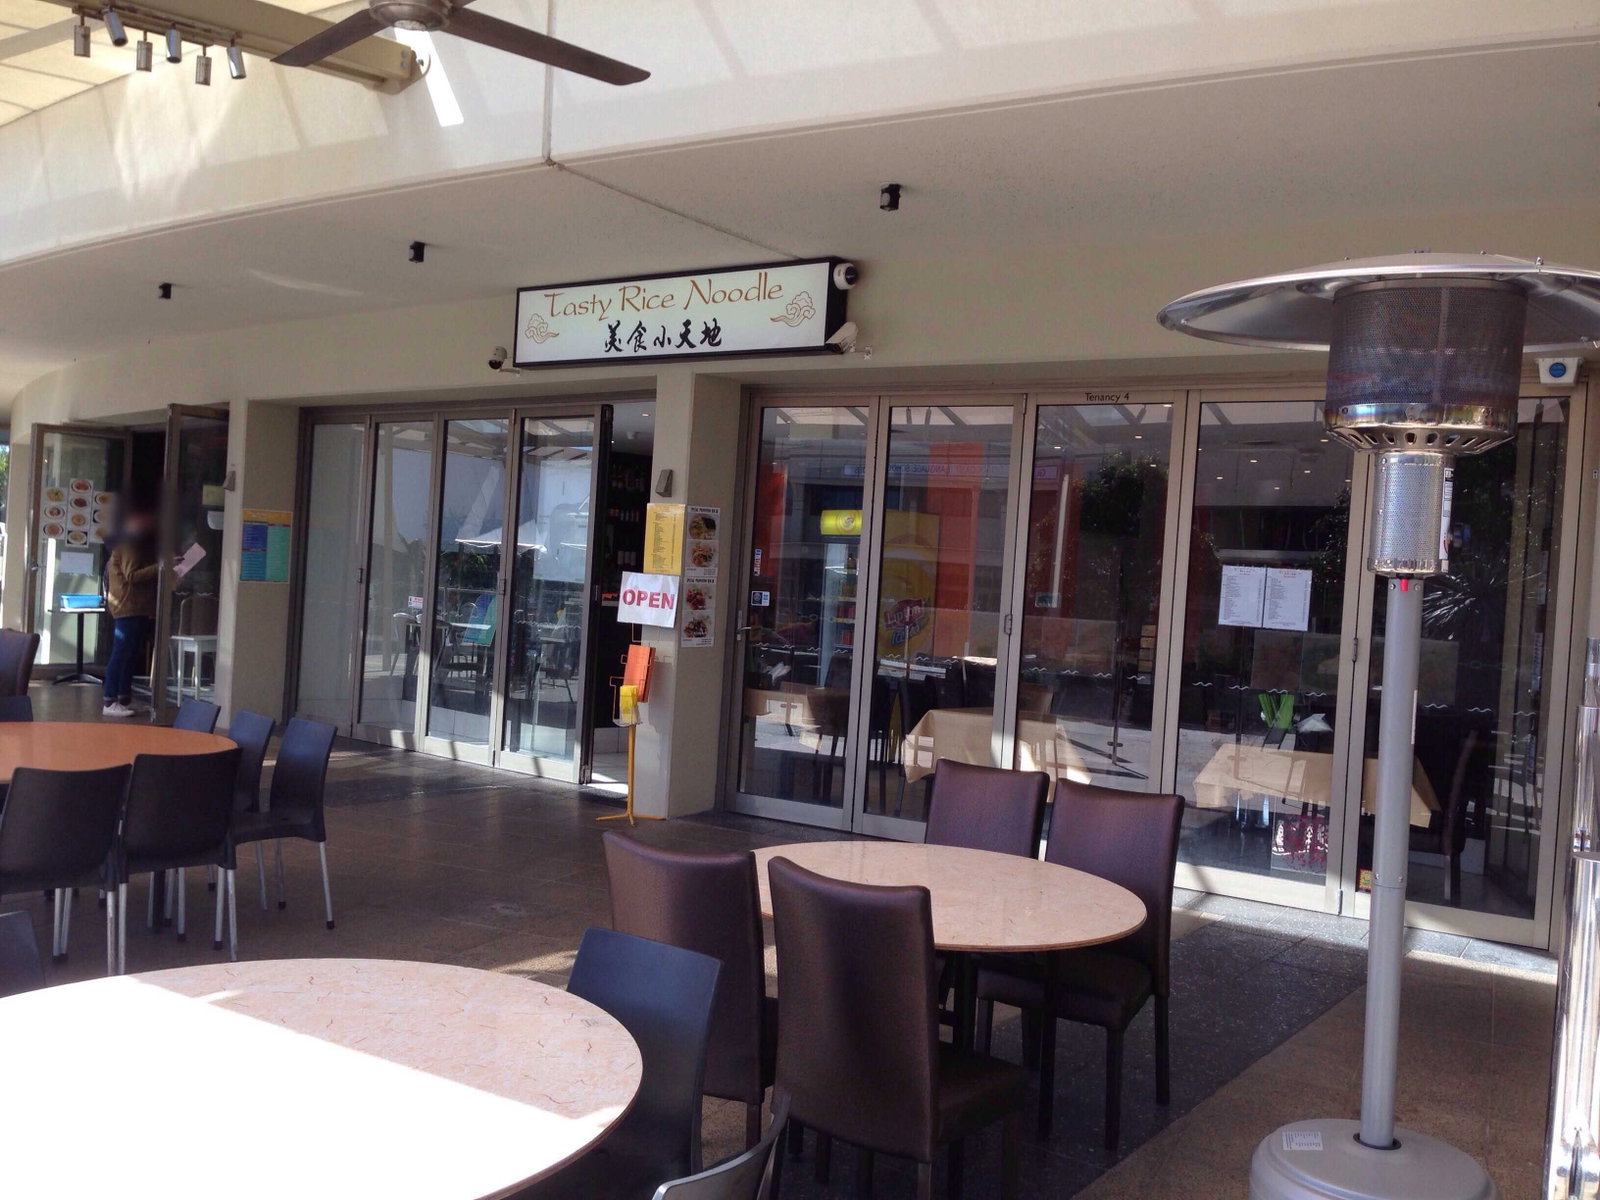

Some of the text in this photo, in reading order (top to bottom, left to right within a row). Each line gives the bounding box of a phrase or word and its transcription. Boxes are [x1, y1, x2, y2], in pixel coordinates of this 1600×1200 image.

[543, 271, 784, 321] Tasty Rice Noodle
[604, 317, 722, 353] 美食小天地
[1084, 392, 1130, 403] Tenancy 4
[622, 588, 675, 610] OPEN
